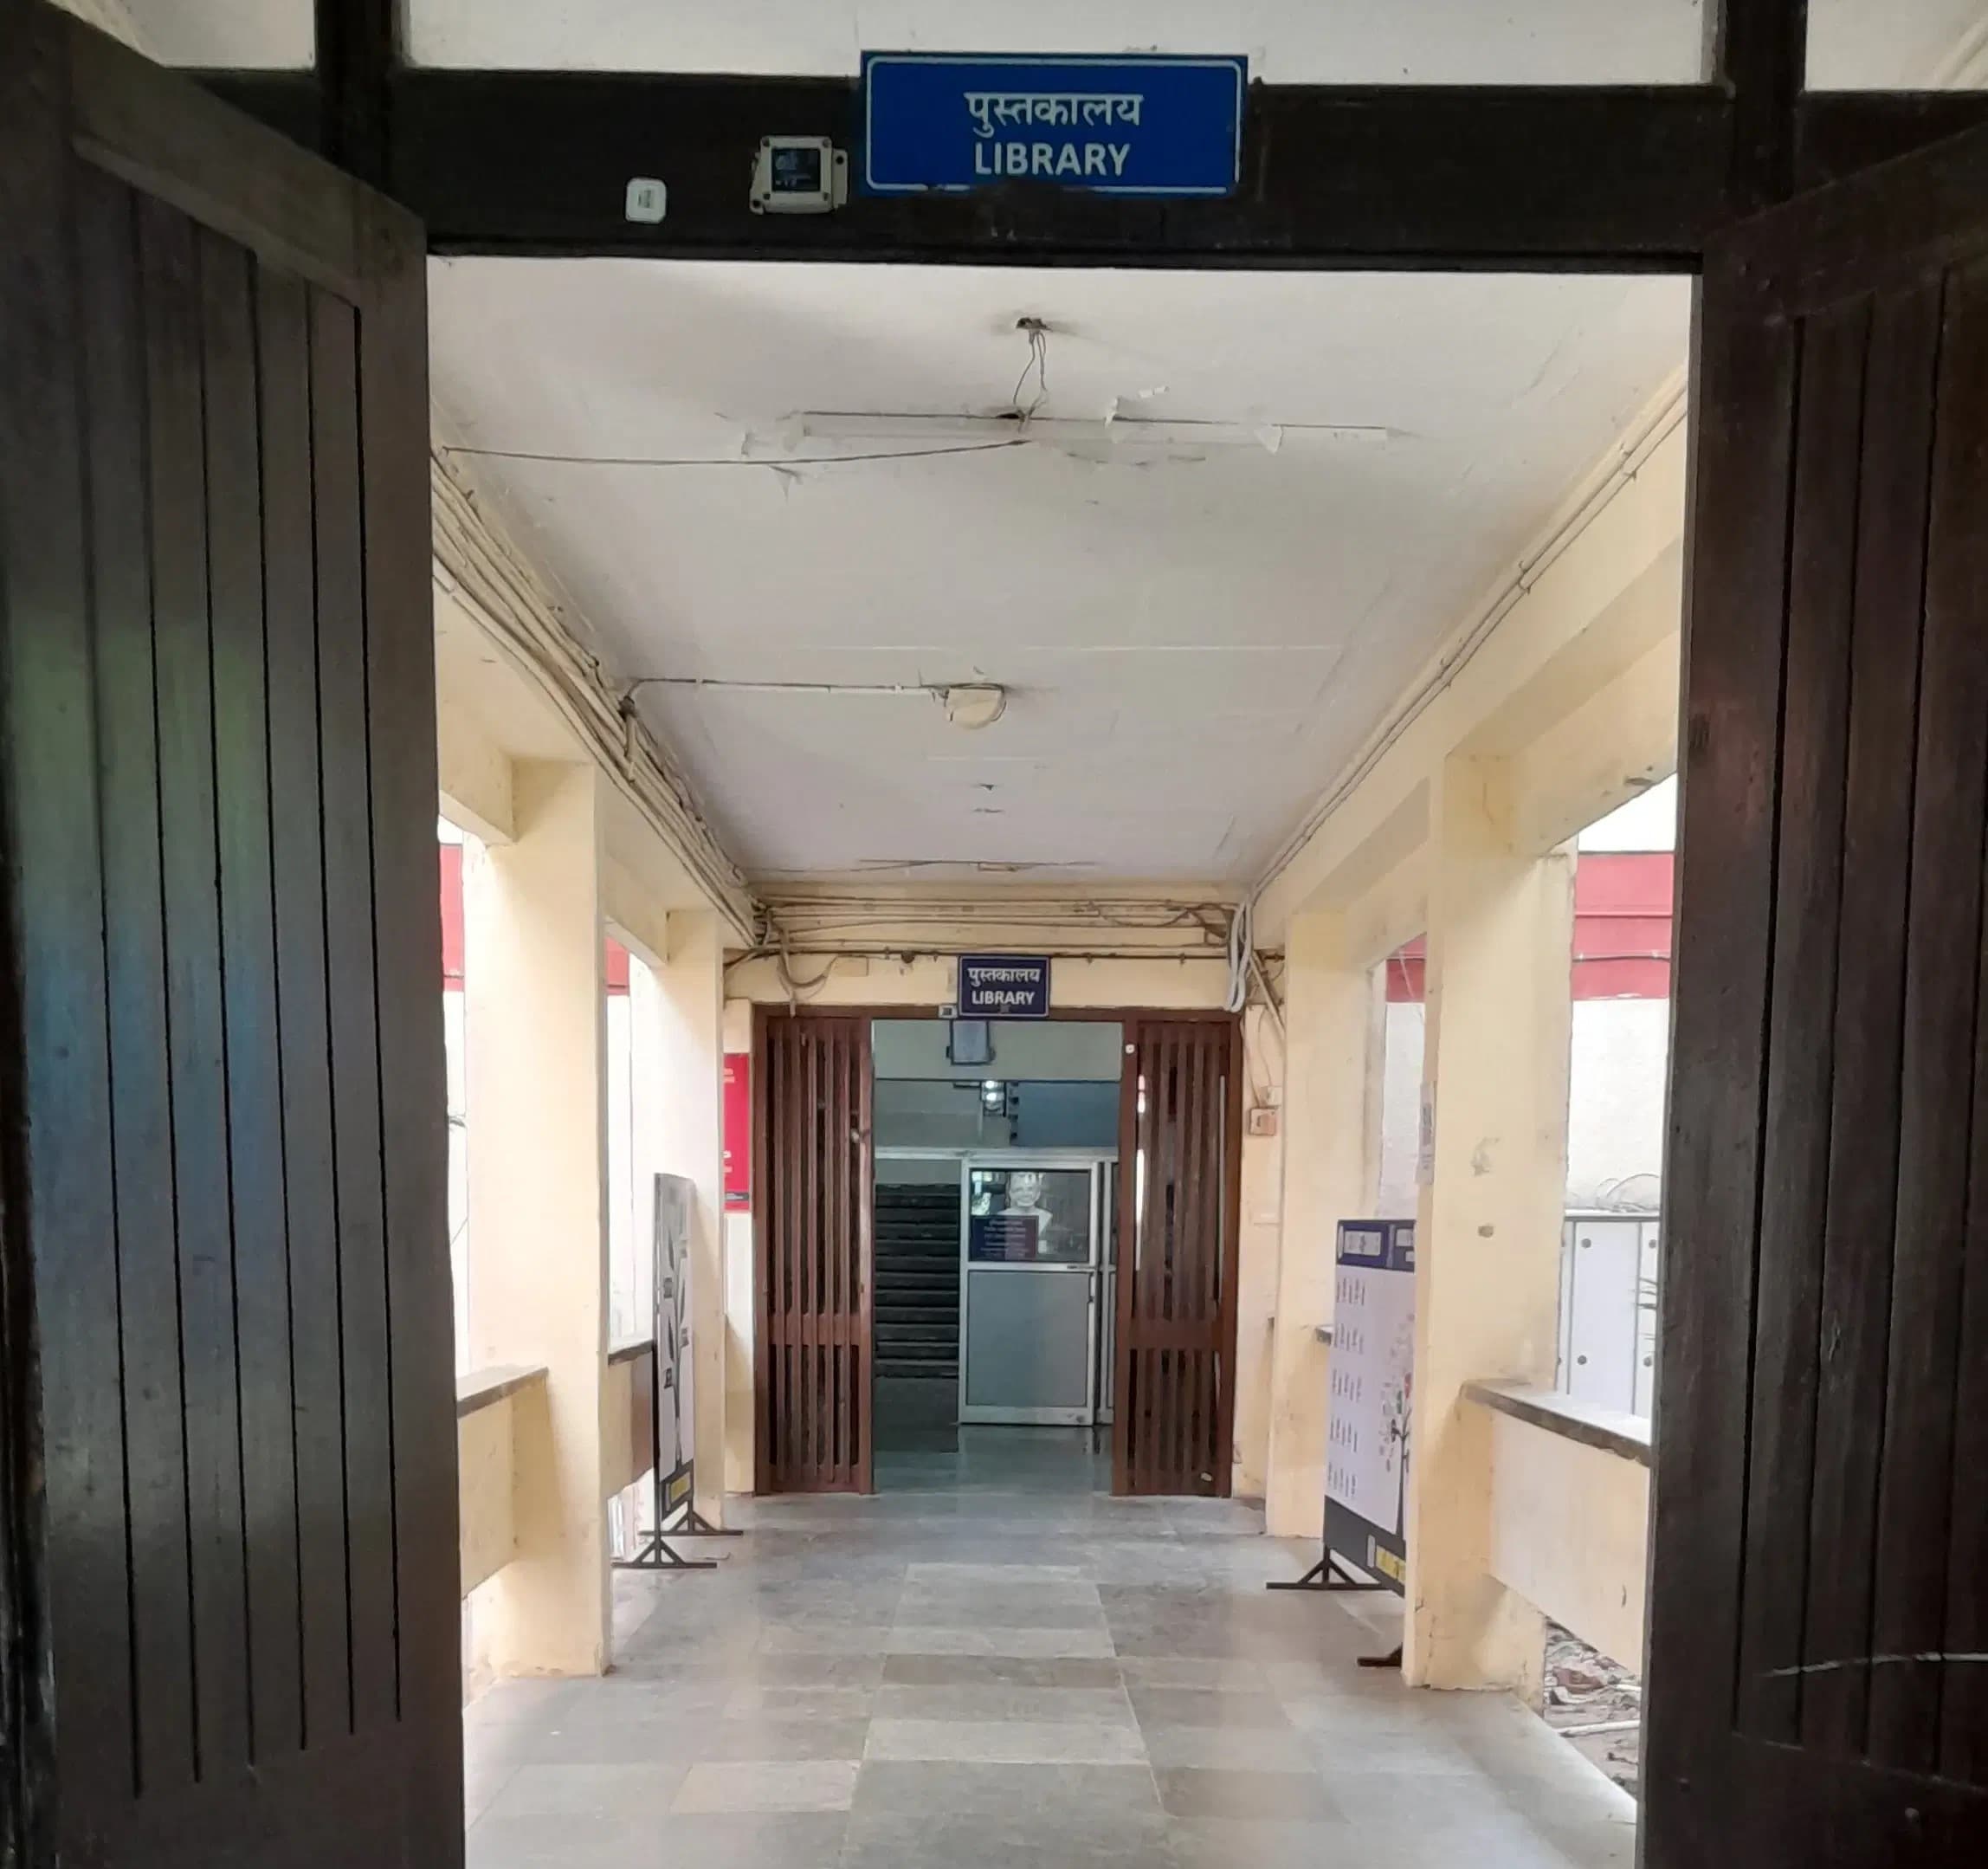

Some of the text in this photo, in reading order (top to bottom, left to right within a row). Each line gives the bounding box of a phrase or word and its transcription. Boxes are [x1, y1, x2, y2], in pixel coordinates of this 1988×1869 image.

[963, 93, 1144, 138] पुस्तकालय
[975, 142, 1131, 176] LIBRARY
[967, 967, 1041, 986] पुस्तकालय
[971, 991, 1036, 1005] LIBRARY
